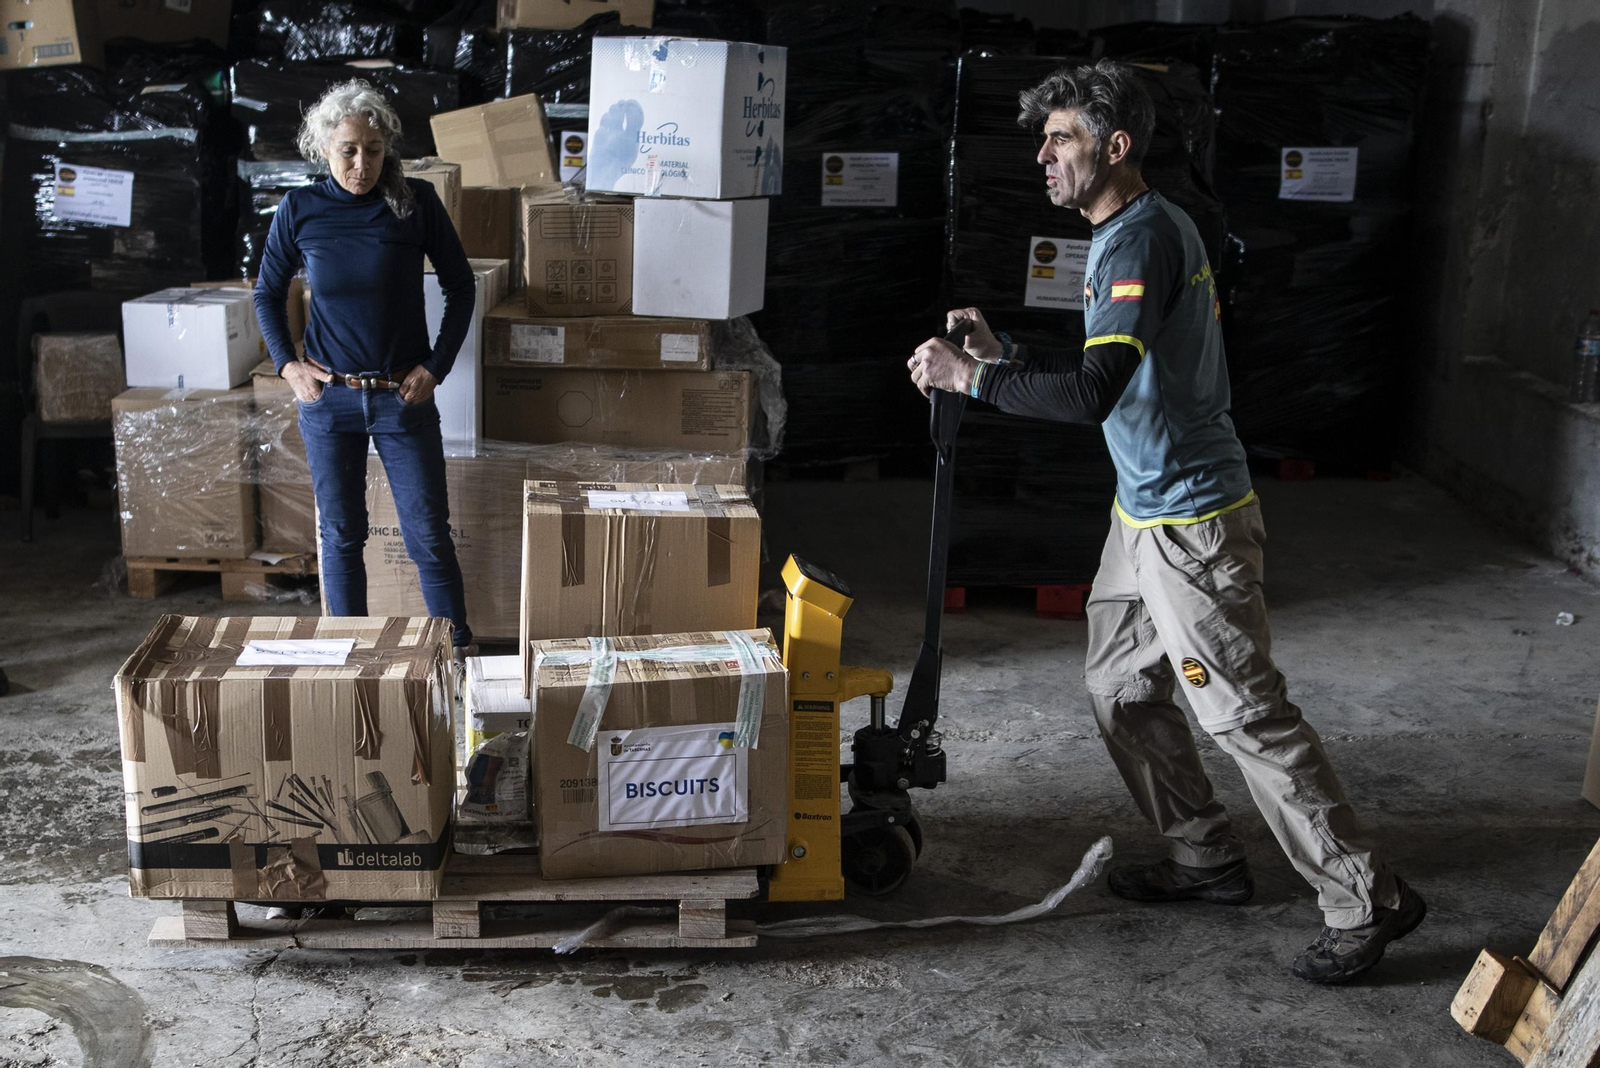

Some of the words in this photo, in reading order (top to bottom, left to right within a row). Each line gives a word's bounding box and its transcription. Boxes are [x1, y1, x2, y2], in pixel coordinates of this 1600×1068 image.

[743, 96, 782, 120] Herbitas
[636, 130, 691, 147] Herbitas
[559, 777, 598, 789] 209138
[625, 777, 720, 800] BISCUITS
[802, 812, 832, 821] Baxtran
[356, 851, 422, 867] deltalab
